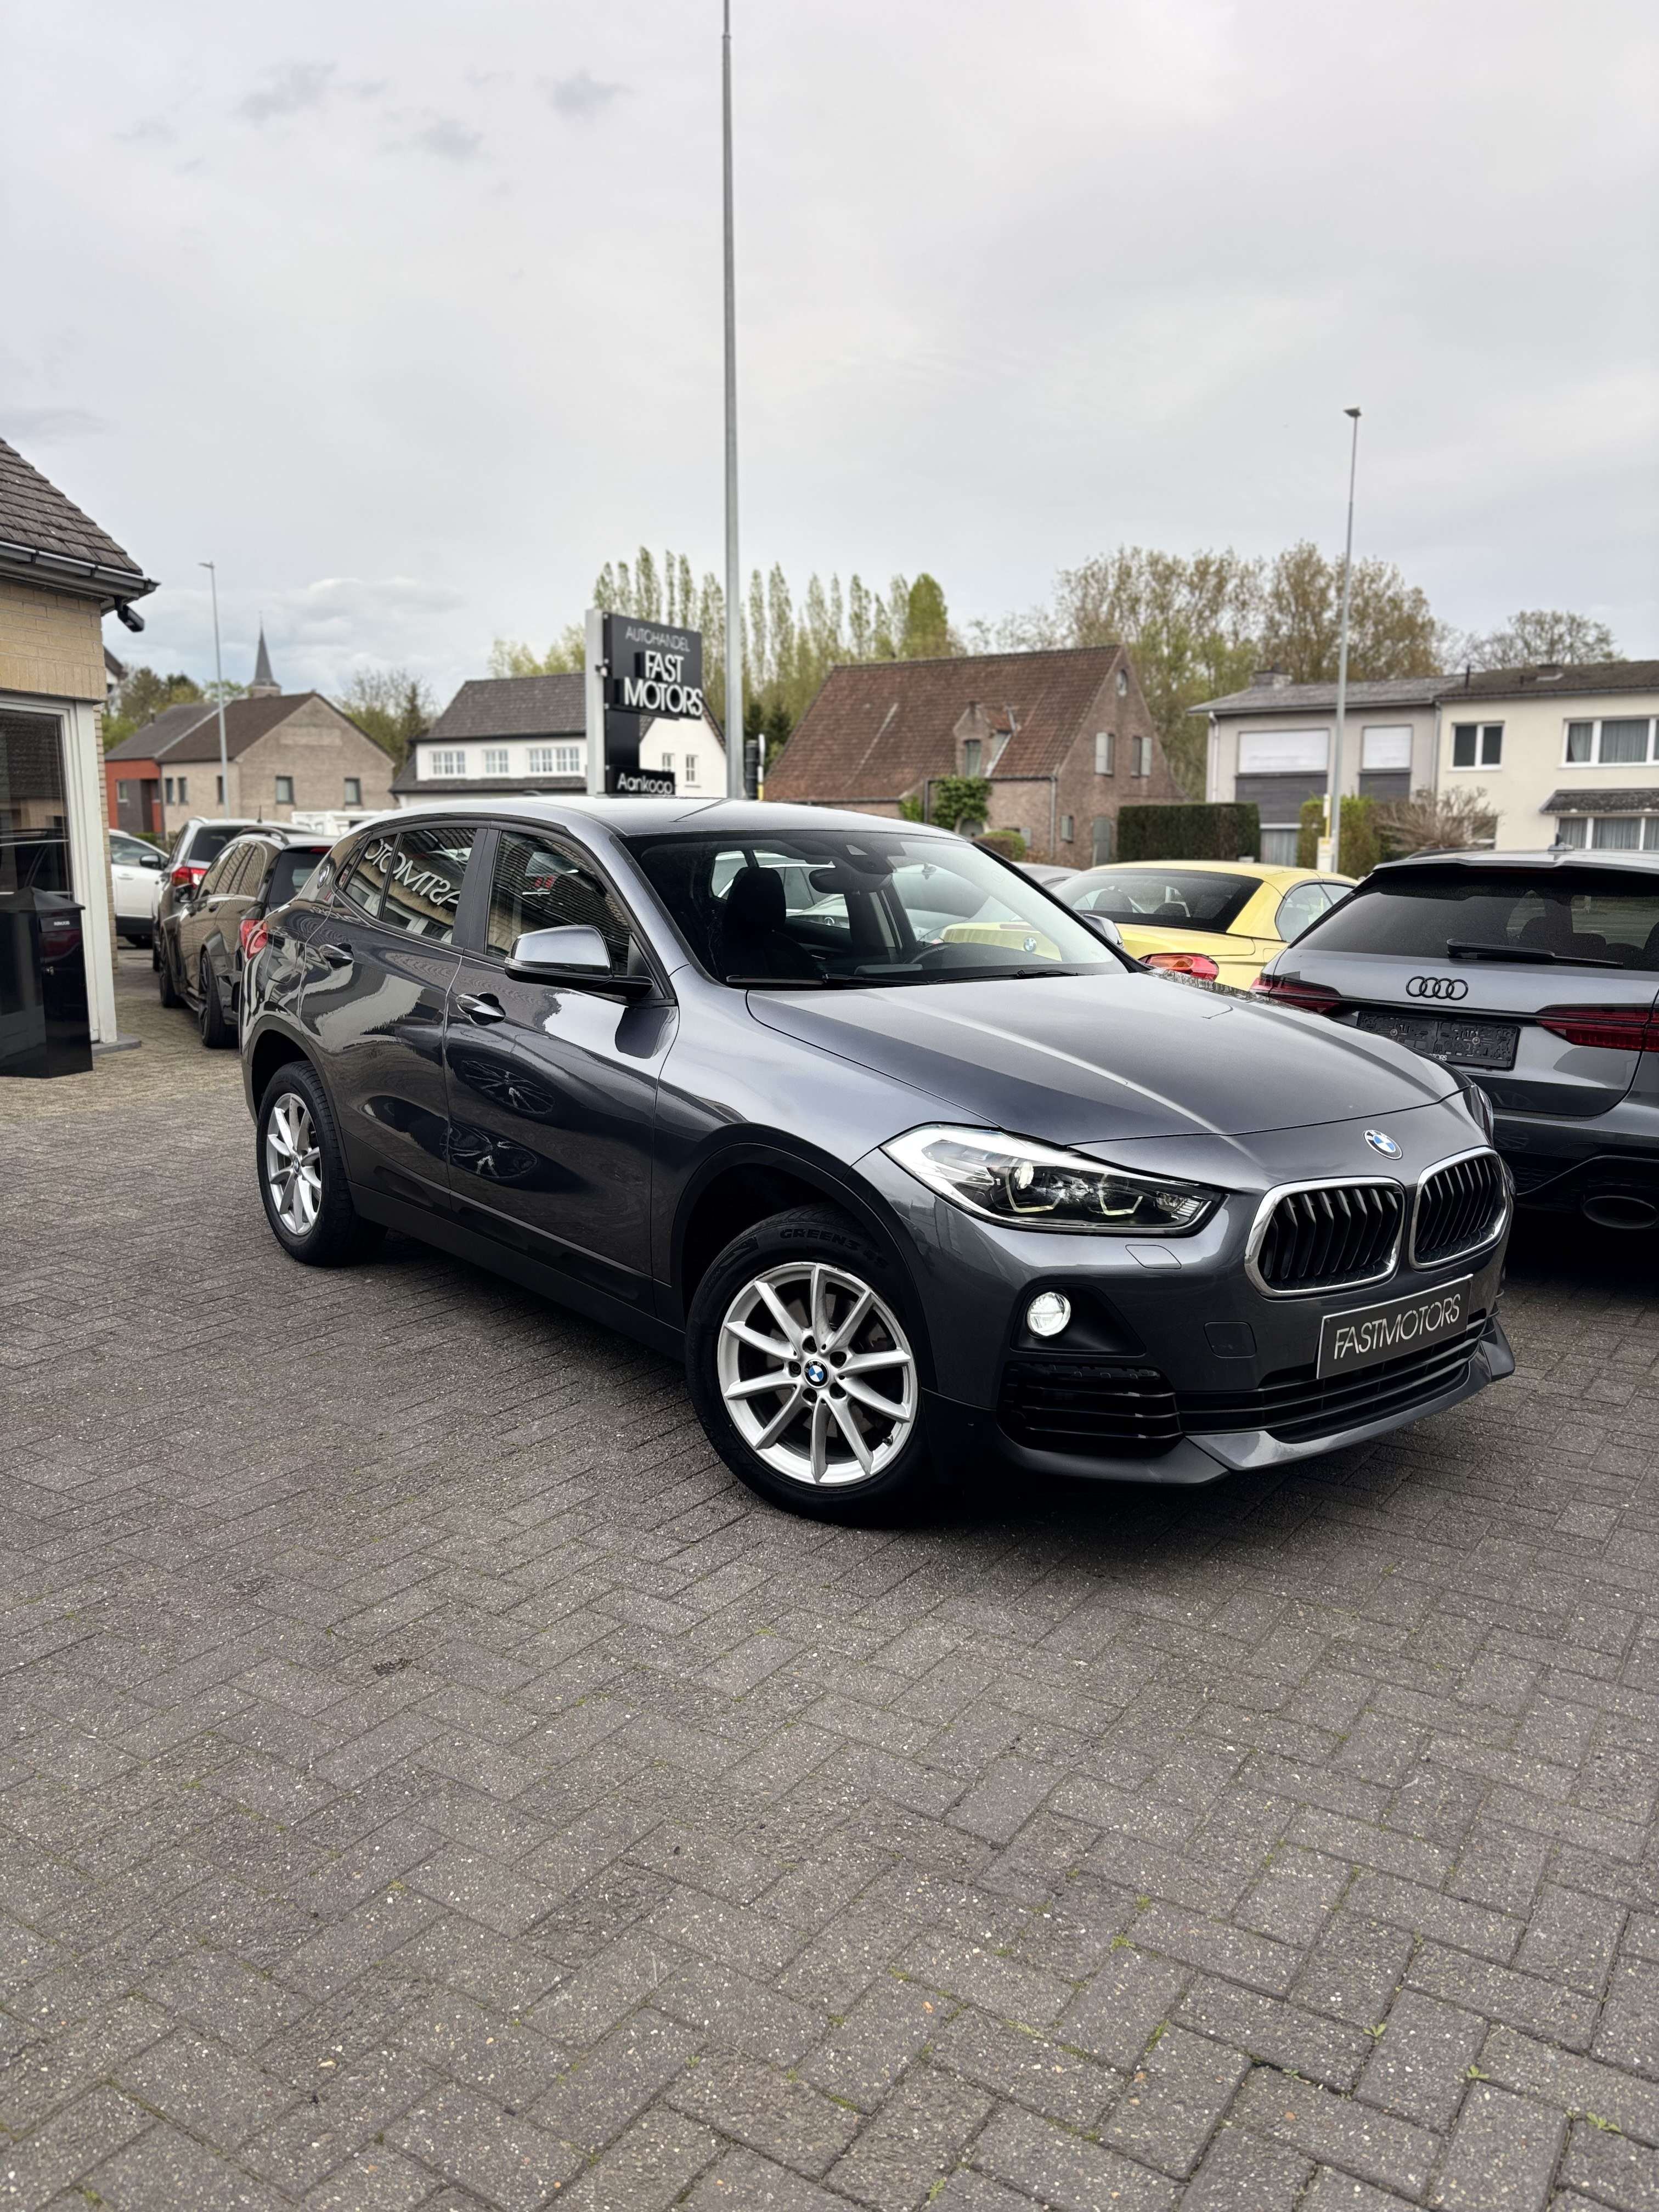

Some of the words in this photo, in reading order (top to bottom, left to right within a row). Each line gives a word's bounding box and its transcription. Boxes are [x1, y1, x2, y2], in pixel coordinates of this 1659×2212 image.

[625, 626, 690, 652] AUTOHANDEL
[645, 650, 684, 682] FAST
[624, 677, 703, 716] MOTORS
[617, 773, 673, 794] Aankoop
[1334, 1293, 1461, 1360] FASTMOTORS
